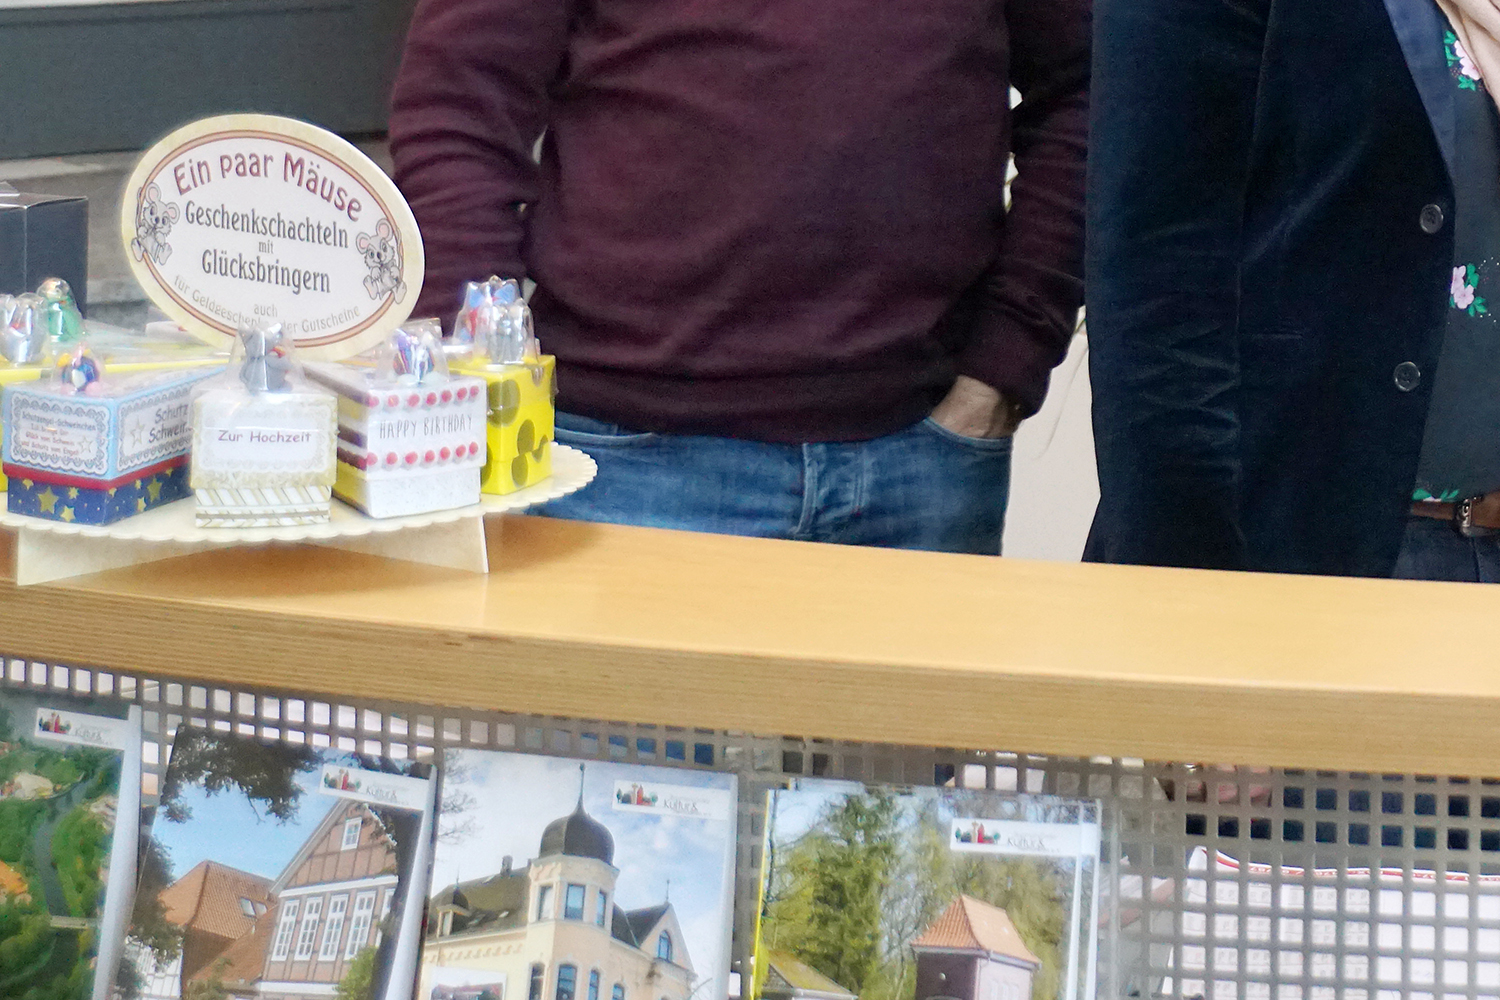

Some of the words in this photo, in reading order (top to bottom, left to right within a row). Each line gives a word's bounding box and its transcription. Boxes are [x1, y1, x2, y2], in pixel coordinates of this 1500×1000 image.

[174, 158, 212, 196] Ein
[283, 152, 363, 222] Mäuse
[185, 200, 349, 249] Geschenkschachteln
[258, 239, 274, 254] mit
[202, 249, 331, 295] Glücksbringern
[174, 274, 191, 295] für
[301, 305, 361, 333] Gutscheine
[253, 303, 278, 317] auch
[217, 429, 244, 443] Zur
[250, 431, 312, 443] Hochzeit
[379, 419, 418, 440] HAPPY
[423, 413, 473, 437] BIRTHDAY
